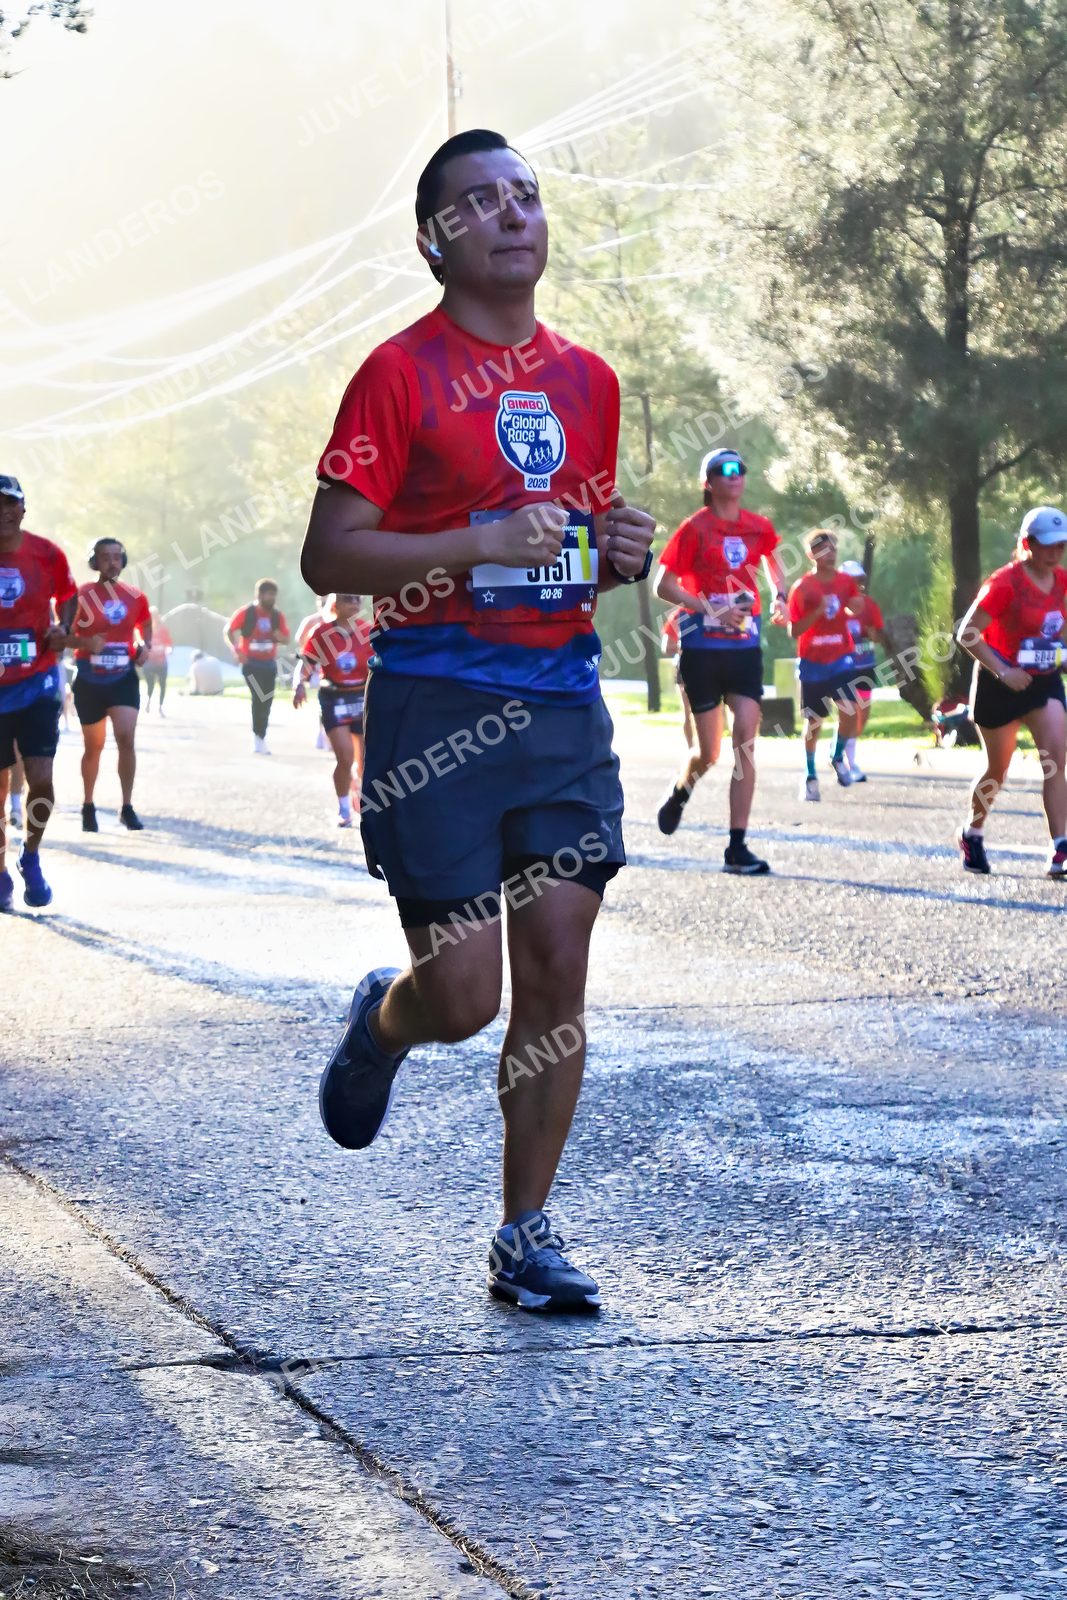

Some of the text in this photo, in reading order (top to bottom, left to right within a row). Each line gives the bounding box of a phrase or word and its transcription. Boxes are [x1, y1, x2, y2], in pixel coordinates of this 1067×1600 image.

[507, 400, 544, 410] BIMBO
[512, 415, 546, 430] Global
[508, 428, 535, 442] Race
[527, 478, 548, 488] 2026
